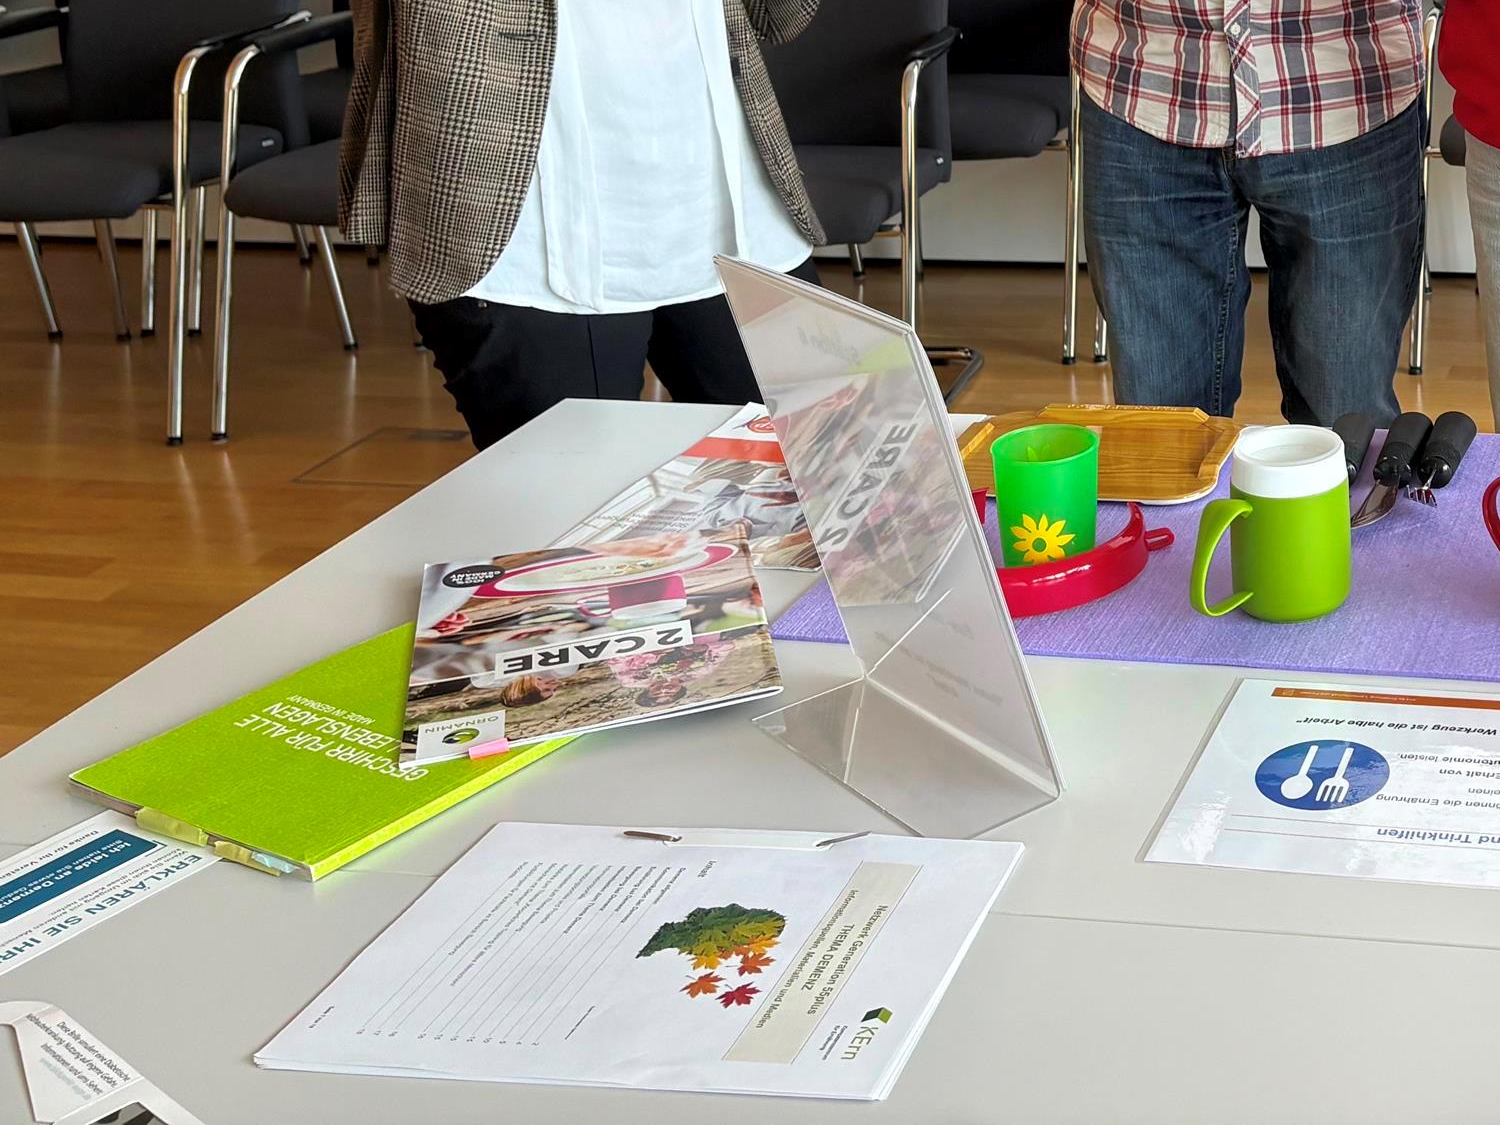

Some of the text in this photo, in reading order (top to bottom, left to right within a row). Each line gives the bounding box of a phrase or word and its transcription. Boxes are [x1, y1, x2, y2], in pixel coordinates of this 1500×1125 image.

[502, 626, 683, 675] 2 CARE
[287, 695, 336, 714] GERMANY
[262, 703, 401, 753] LEBENSLAGEN
[344, 712, 376, 726] MADE
[425, 715, 499, 733] ORNAMIN
[1430, 724, 1497, 735] Werkzeug
[234, 714, 429, 781] GESCHIRR FÜR ALLE
[1374, 793, 1440, 805] Ernährung
[107, 841, 131, 853] Ich
[1375, 828, 1473, 843] Trinkhilfen
[72, 853, 109, 871] leide
[696, 860, 717, 877] Inhalt
[53, 870, 73, 880] an
[0, 854, 202, 964] ERKLÄREN SIE IHR
[856, 905, 888, 938] Netzwerk
[826, 924, 855, 952] THEMA
[782, 951, 816, 987] Materialien
[799, 954, 834, 990] DEMENZ
[825, 940, 865, 984] Generation
[772, 989, 790, 1001] und
[803, 986, 835, 1014] 55plus
[753, 1003, 780, 1028] Medien
[841, 1026, 879, 1060] KErn
